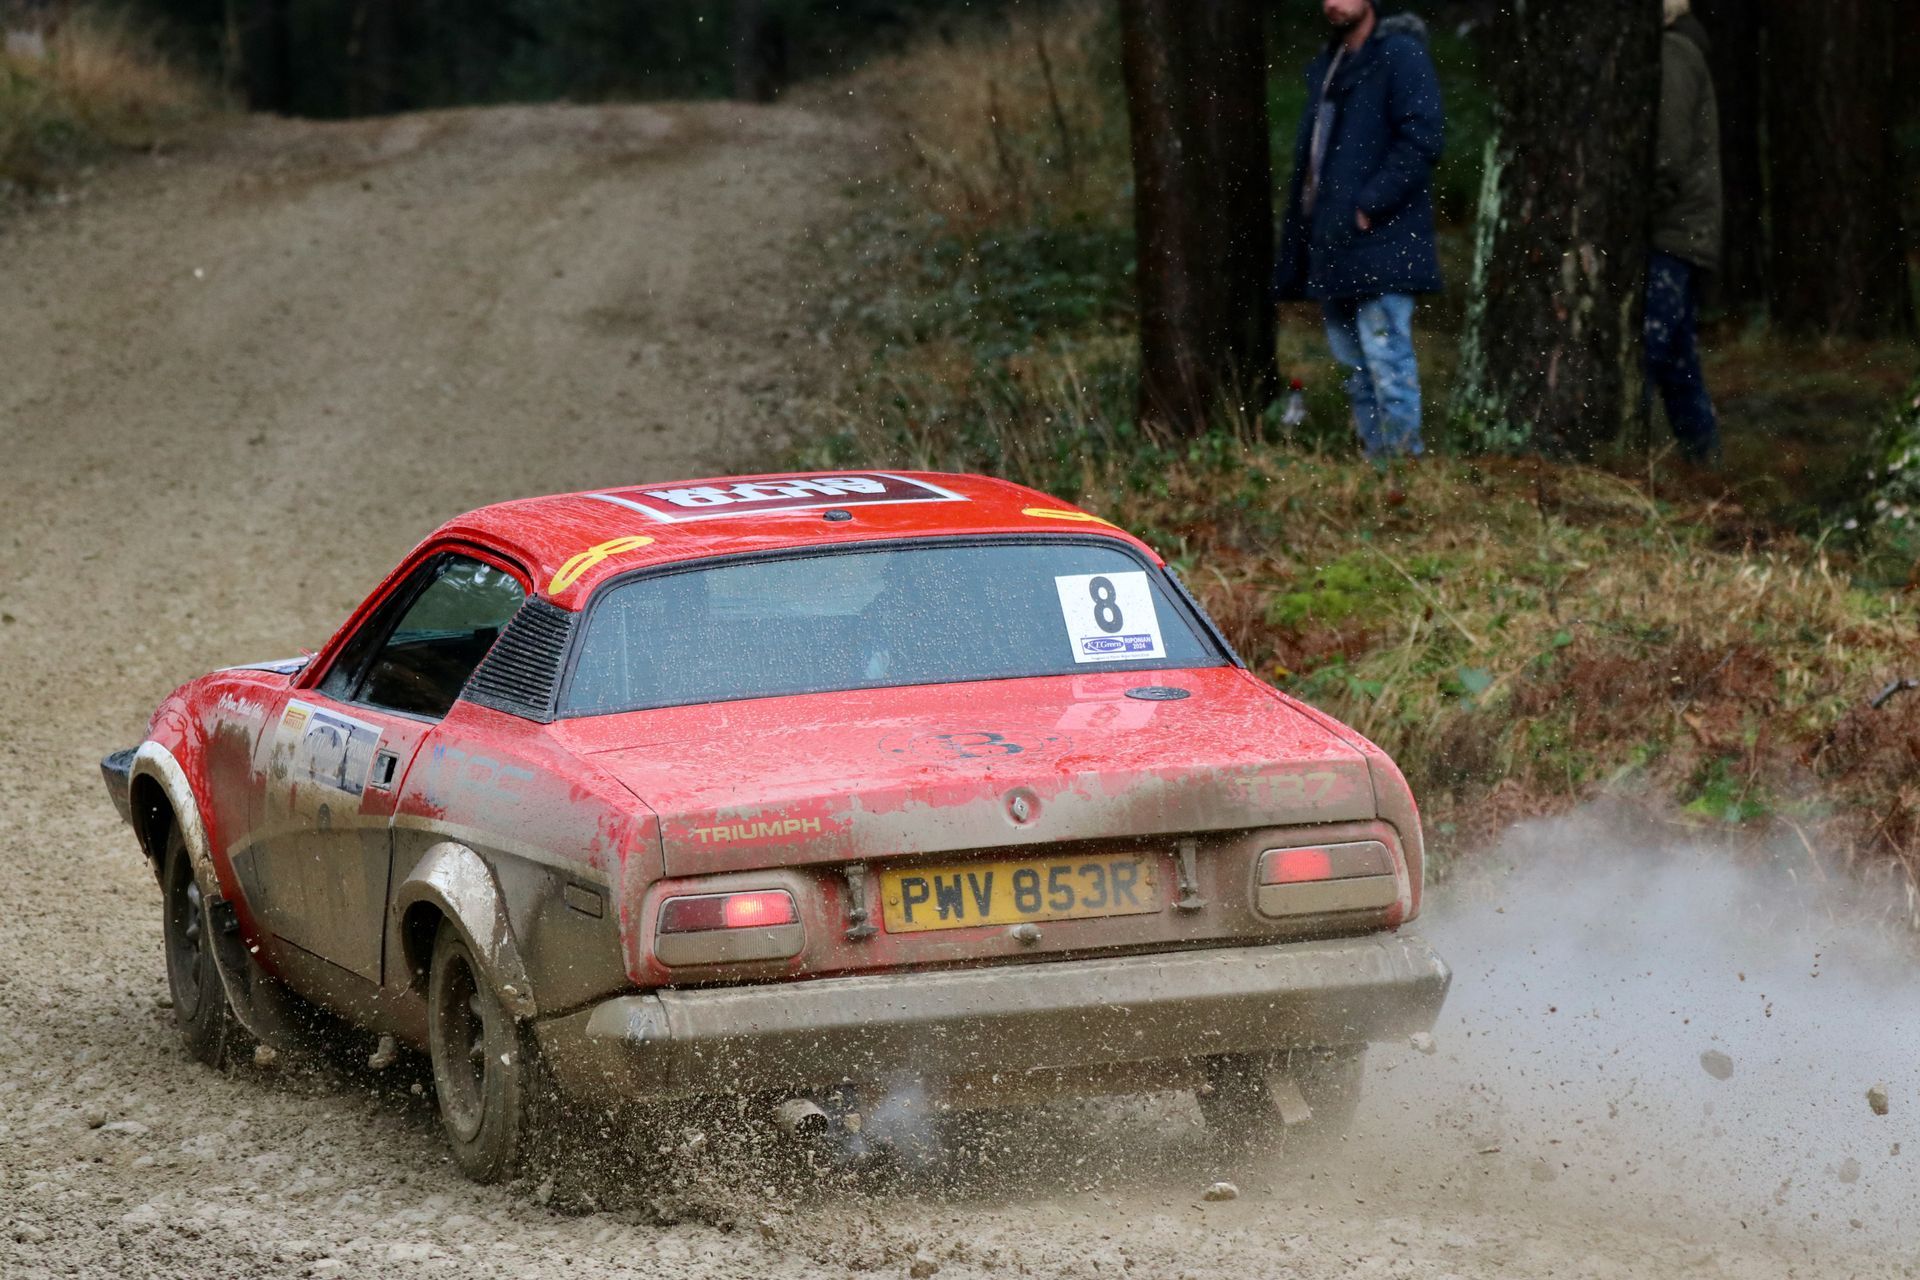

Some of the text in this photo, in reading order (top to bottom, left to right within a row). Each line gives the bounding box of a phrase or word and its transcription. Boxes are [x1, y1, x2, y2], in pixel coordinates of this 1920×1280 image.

[665, 481, 887, 507] AUTO
[1089, 576, 1123, 633] 8
[695, 817, 821, 843] TRIUMPH
[901, 862, 1139, 923] PWV 853R
